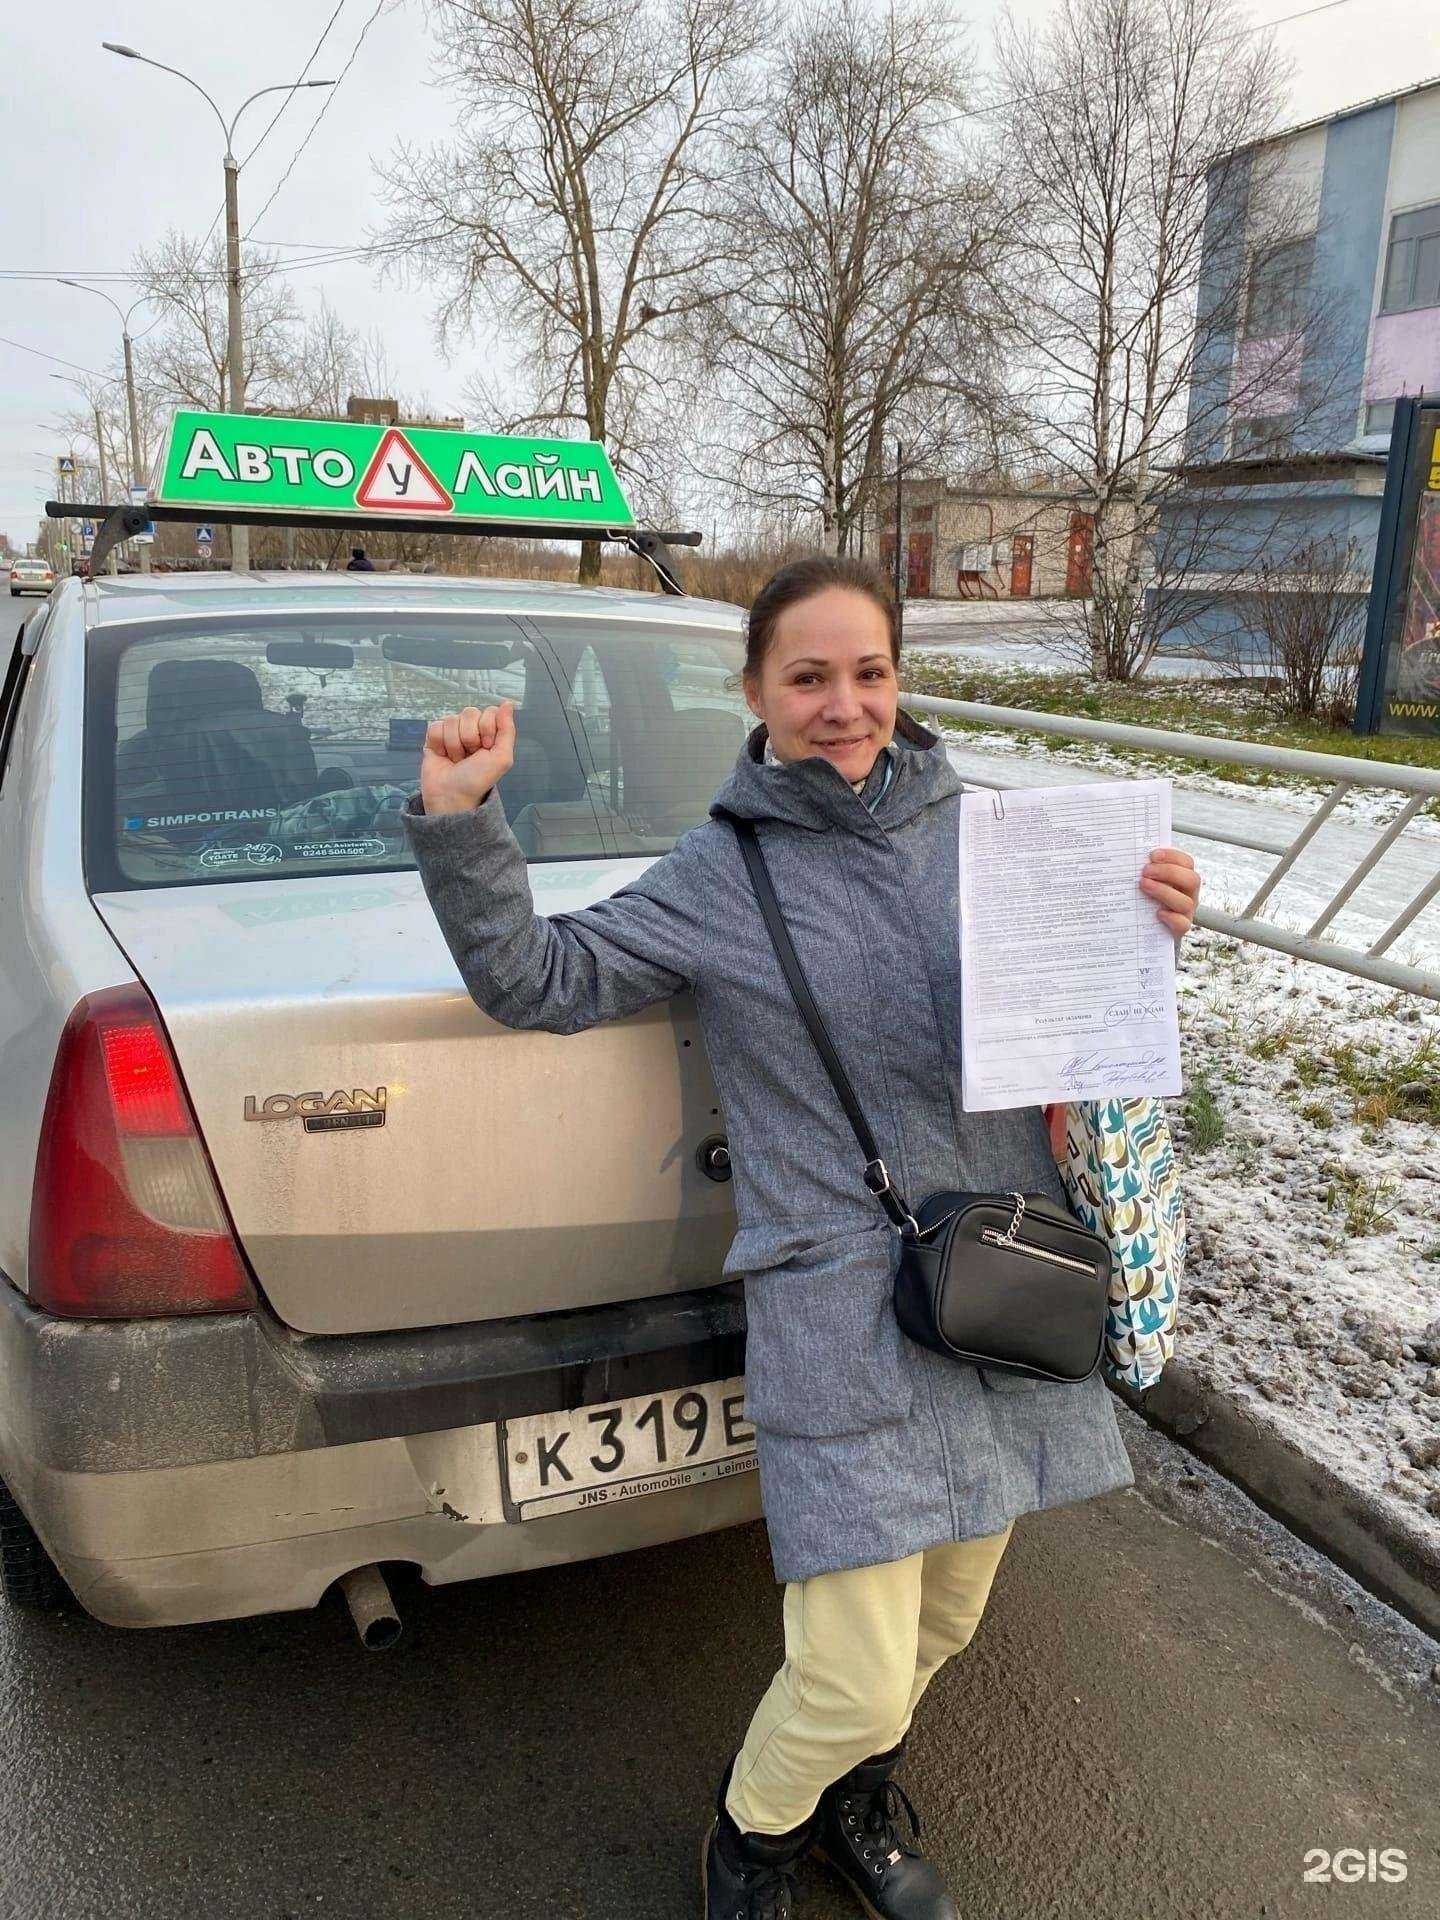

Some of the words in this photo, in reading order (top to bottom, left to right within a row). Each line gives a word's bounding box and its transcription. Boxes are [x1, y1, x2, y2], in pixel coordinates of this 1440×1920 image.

[453, 450, 603, 503] Лайн
[147, 808, 277, 828] SIMPOTRANS
[244, 1086, 387, 1121] LOGAN
[578, 1489, 608, 1506] JNS
[620, 1472, 692, 1497] Automobile
[717, 1456, 759, 1477] Leimen
